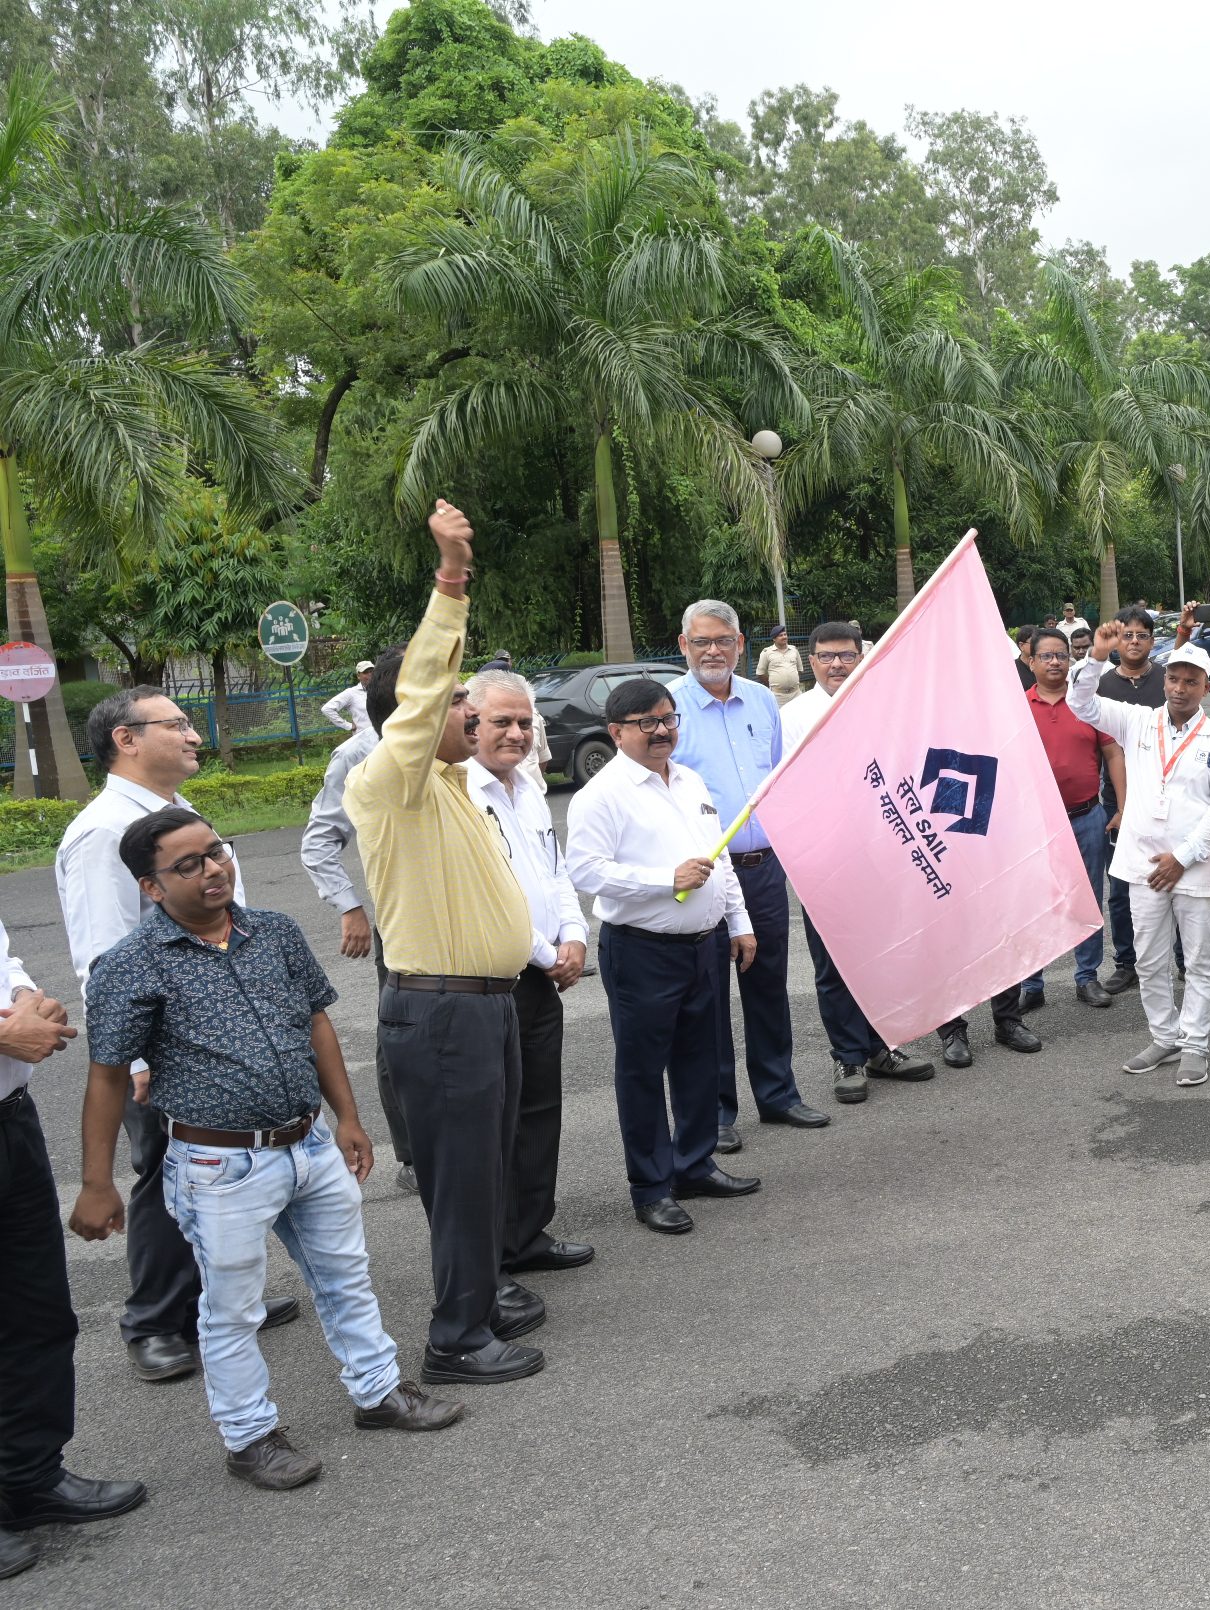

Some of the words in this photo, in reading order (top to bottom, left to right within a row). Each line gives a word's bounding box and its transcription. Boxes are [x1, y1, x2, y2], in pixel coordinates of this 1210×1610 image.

[864, 757, 885, 788] एक
[880, 791, 915, 845] महारत्न
[911, 845, 952, 900] कम्पनी
[896, 775, 923, 815] सेल
[916, 819, 947, 863] SAIL
